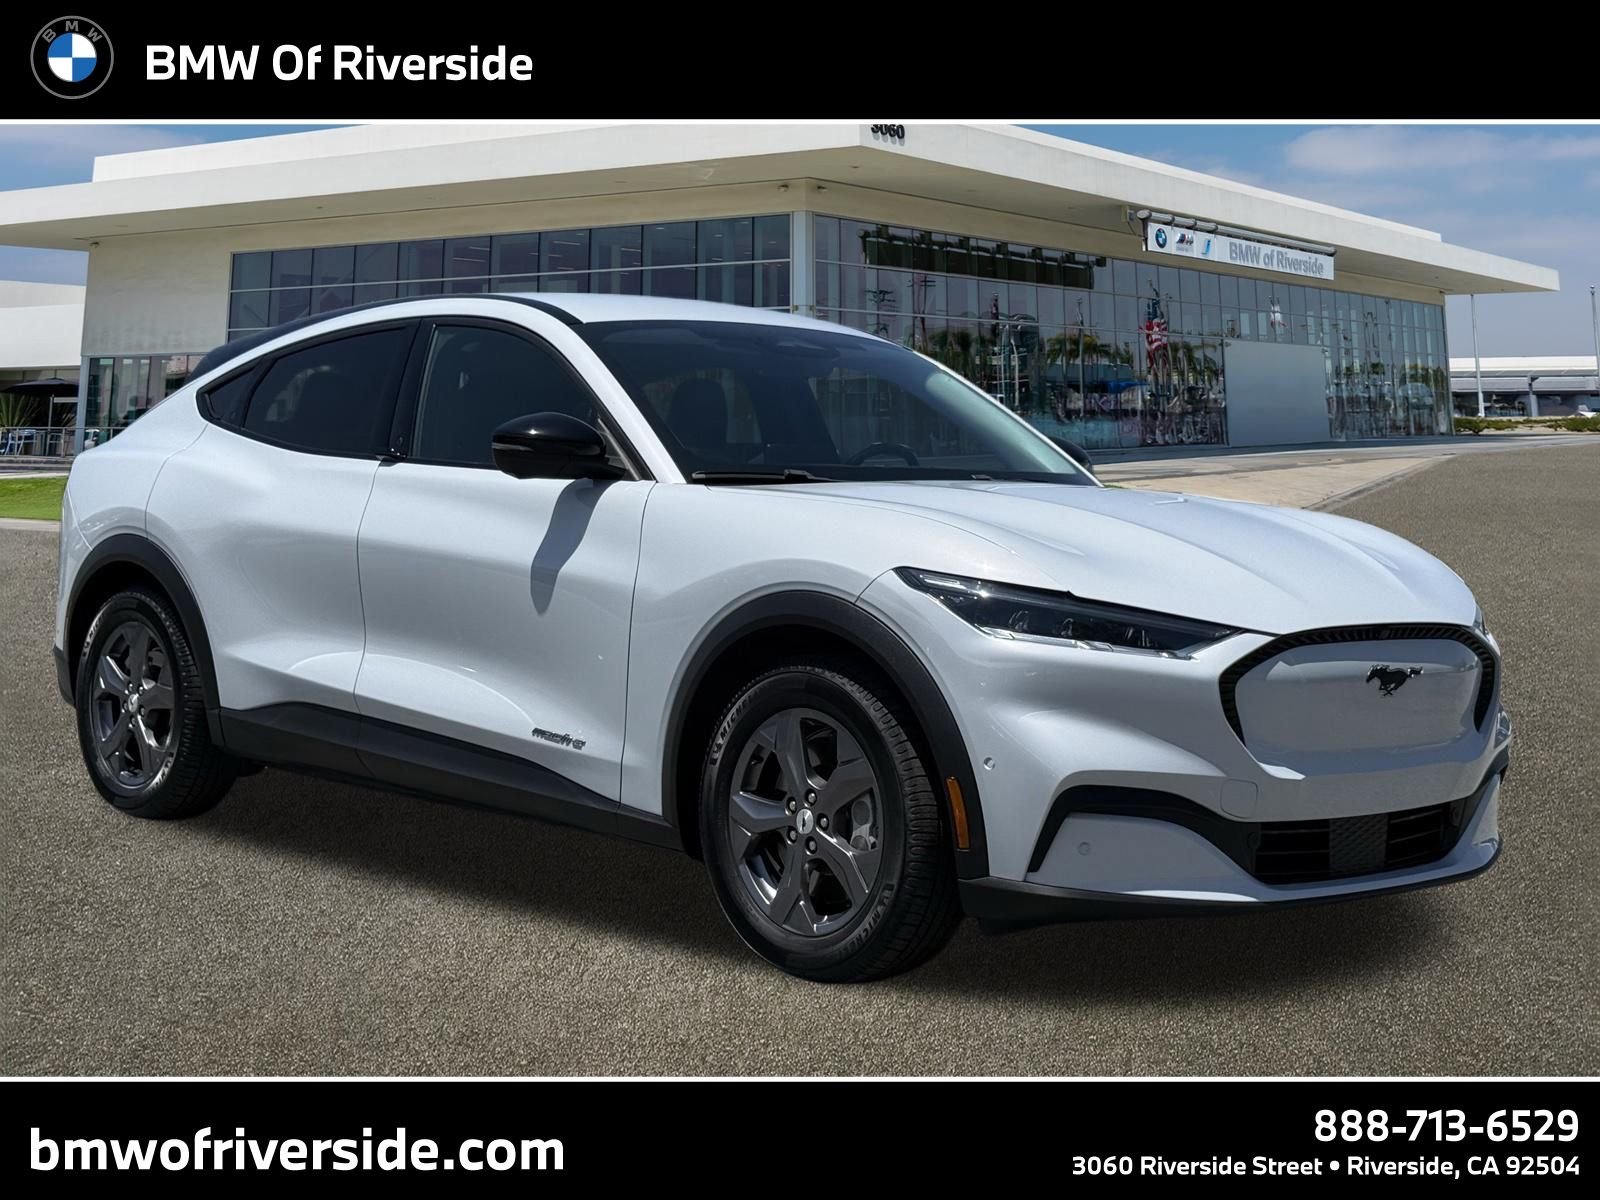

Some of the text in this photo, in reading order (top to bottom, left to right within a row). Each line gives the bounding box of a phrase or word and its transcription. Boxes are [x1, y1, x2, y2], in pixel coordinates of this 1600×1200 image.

[1229, 241, 1324, 275] BMW of Riverside
